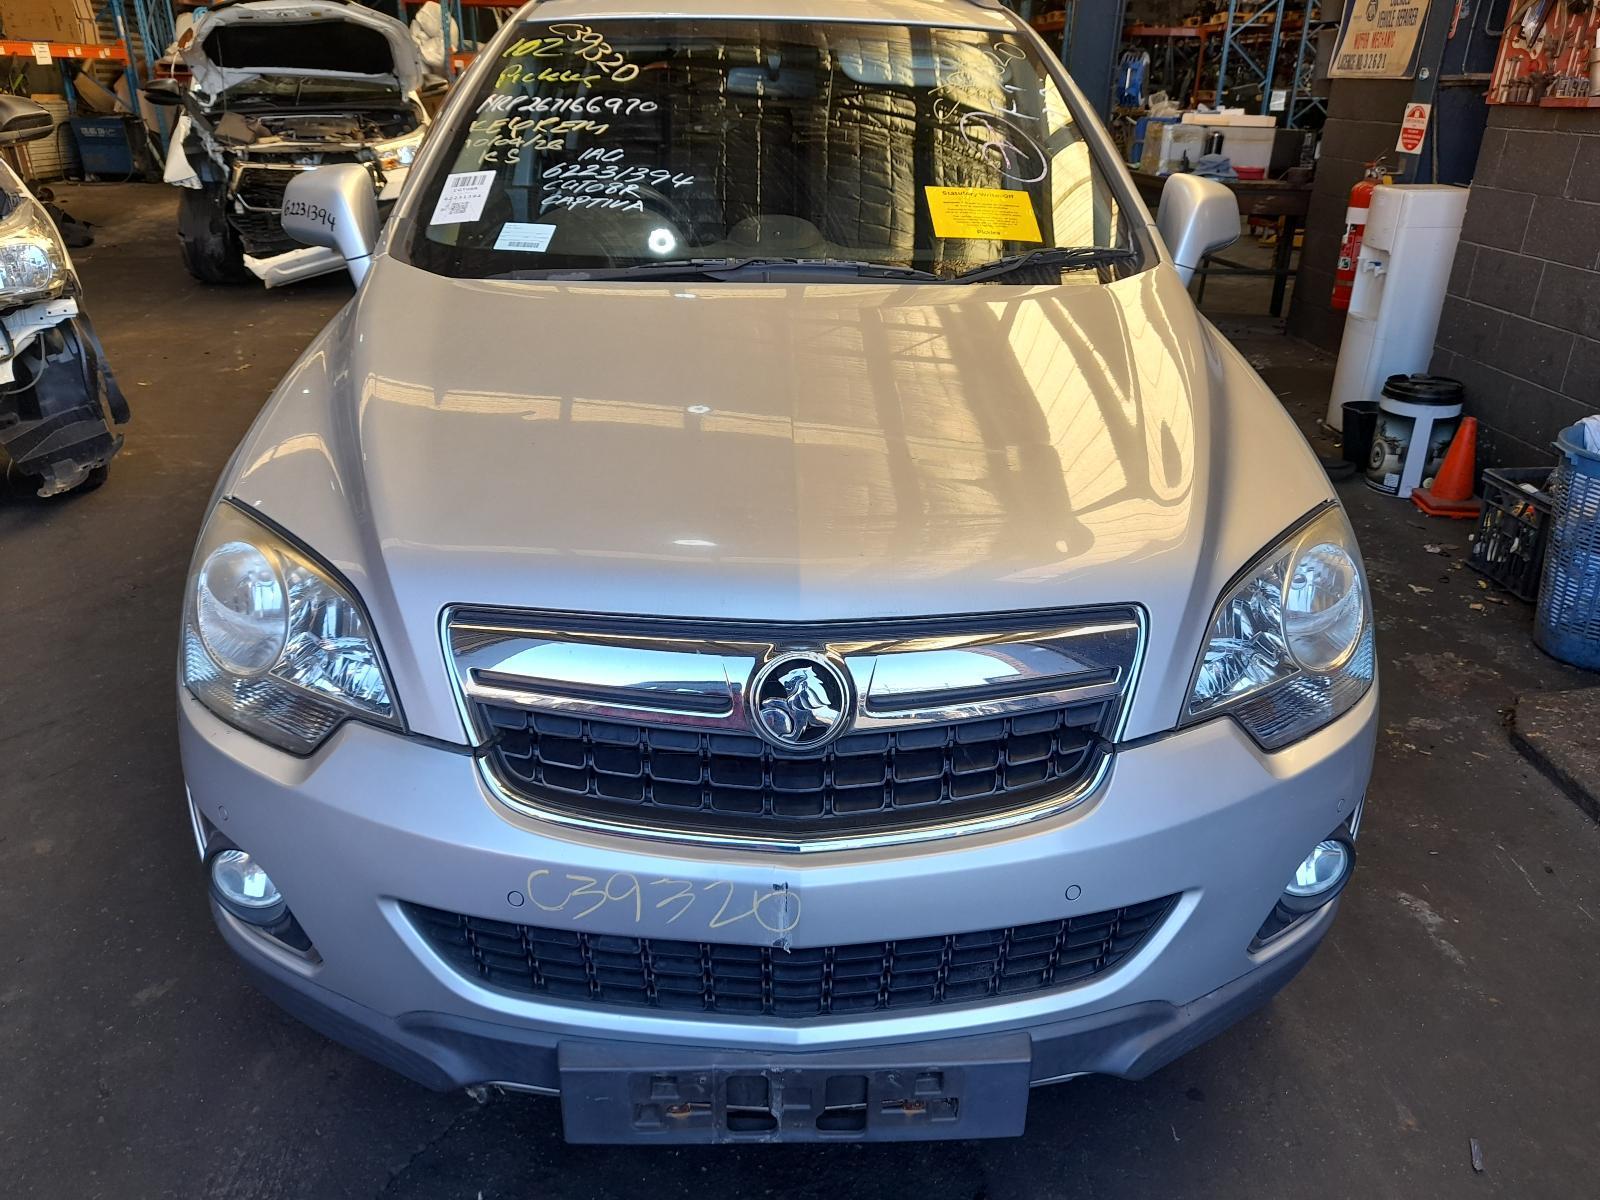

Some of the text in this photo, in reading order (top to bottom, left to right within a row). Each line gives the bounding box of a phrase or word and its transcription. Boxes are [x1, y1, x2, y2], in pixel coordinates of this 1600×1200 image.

[1363, 52, 1387, 70] 32621
[542, 162, 695, 188] 62231394
[541, 193, 644, 213] CAPTIVA
[528, 869, 801, 933] C39320
